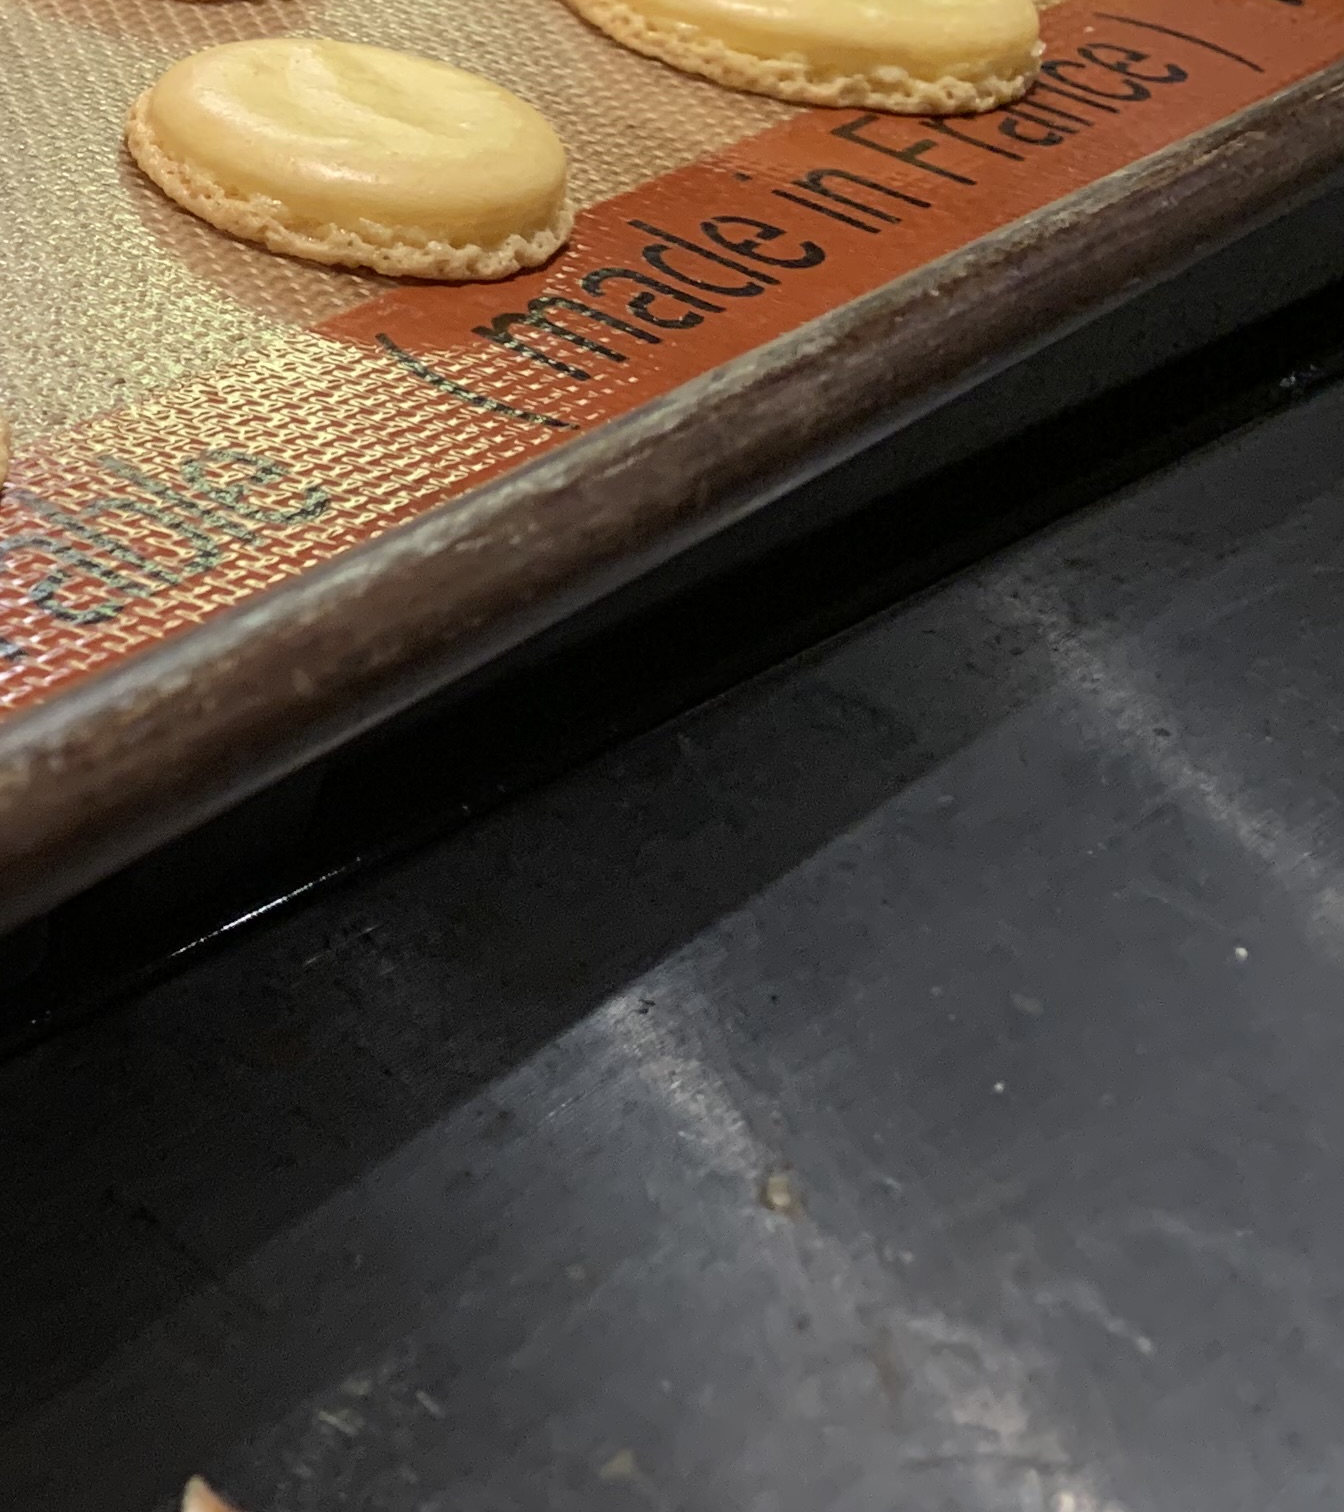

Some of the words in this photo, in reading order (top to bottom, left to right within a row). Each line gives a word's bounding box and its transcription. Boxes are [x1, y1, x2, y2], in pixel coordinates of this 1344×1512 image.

[472, 214, 827, 382] made
[735, 166, 904, 234] in
[831, 41, 1191, 210] France
